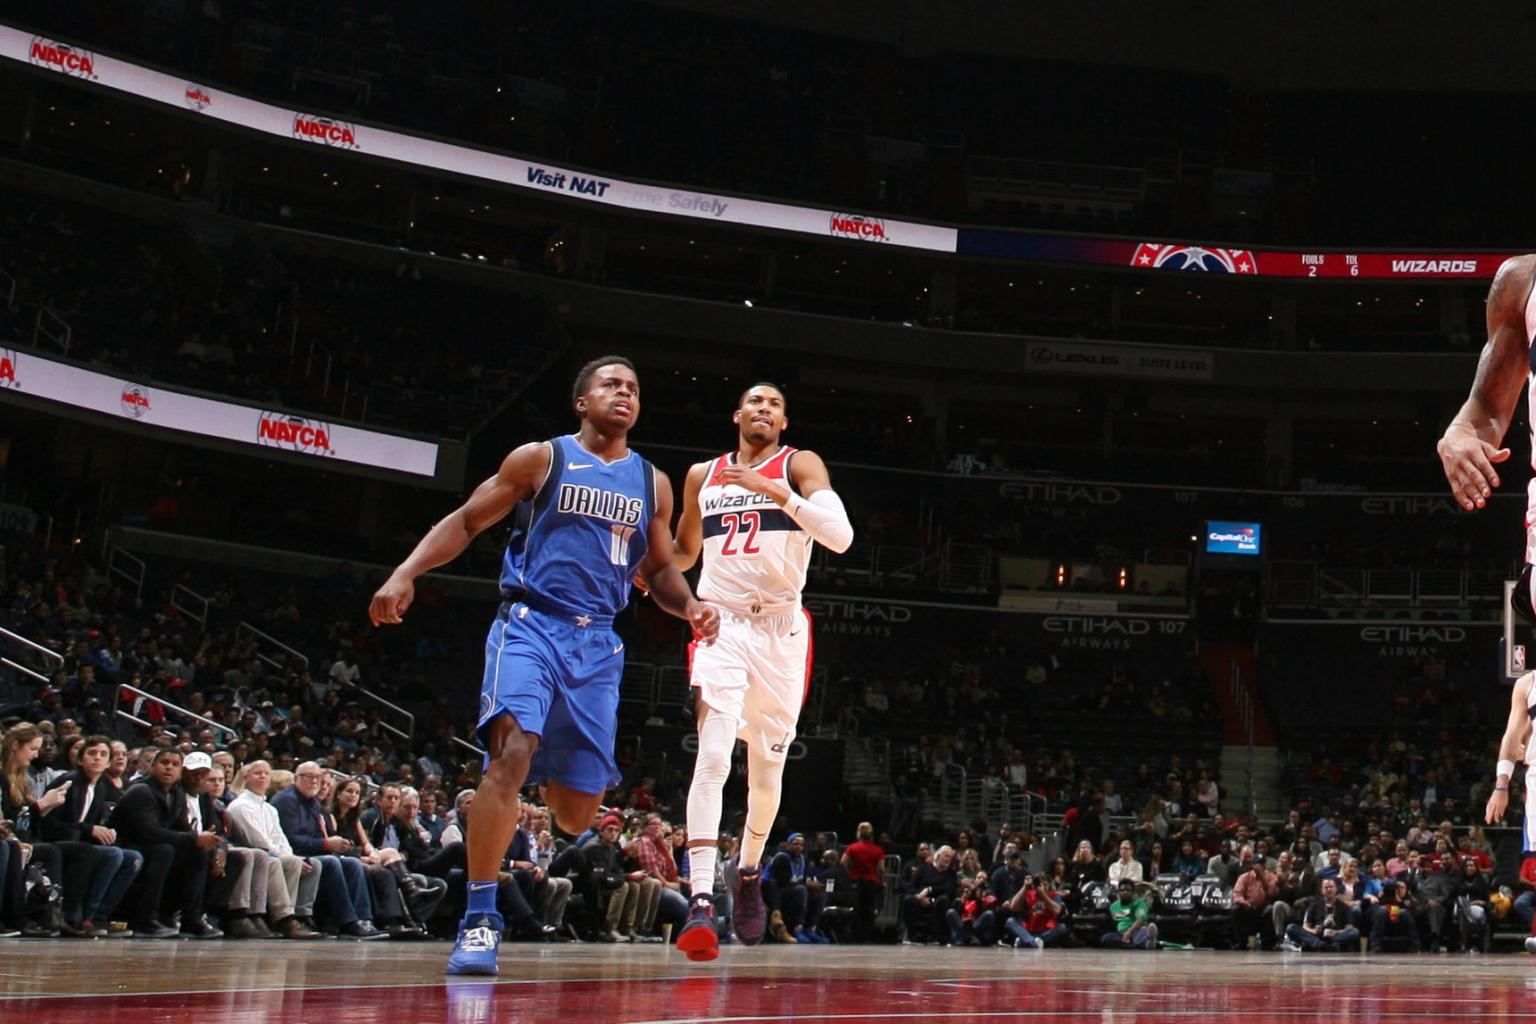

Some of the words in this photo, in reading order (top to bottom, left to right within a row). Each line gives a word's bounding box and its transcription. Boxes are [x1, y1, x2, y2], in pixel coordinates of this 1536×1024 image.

[31, 42, 94, 75] NATCA
[294, 118, 355, 145] NATCA
[527, 167, 566, 190] Visit
[570, 176, 609, 198] NAT
[668, 192, 728, 217] Safely
[831, 216, 885, 238] NATCA
[1302, 255, 1324, 266] FOULS
[1392, 260, 1477, 273] WIZARDS
[1308, 266, 1317, 277] 2
[1350, 265, 1359, 276] 6
[1055, 351, 1120, 366] LEXUS
[121, 391, 149, 408] NATCA
[259, 418, 330, 450] NATCA
[999, 481, 1123, 504] ETIHAD
[1174, 492, 1198, 503] 107
[558, 483, 644, 526] DALLAS
[720, 513, 760, 556] 22
[804, 600, 912, 622] ETIHAD
[821, 622, 892, 637] AIRWAYS
[1042, 617, 1151, 635] ETIHAD
[1158, 621, 1187, 634] 107
[1359, 626, 1467, 642] ETIHAD
[1061, 637, 1131, 650] AIRWAYS
